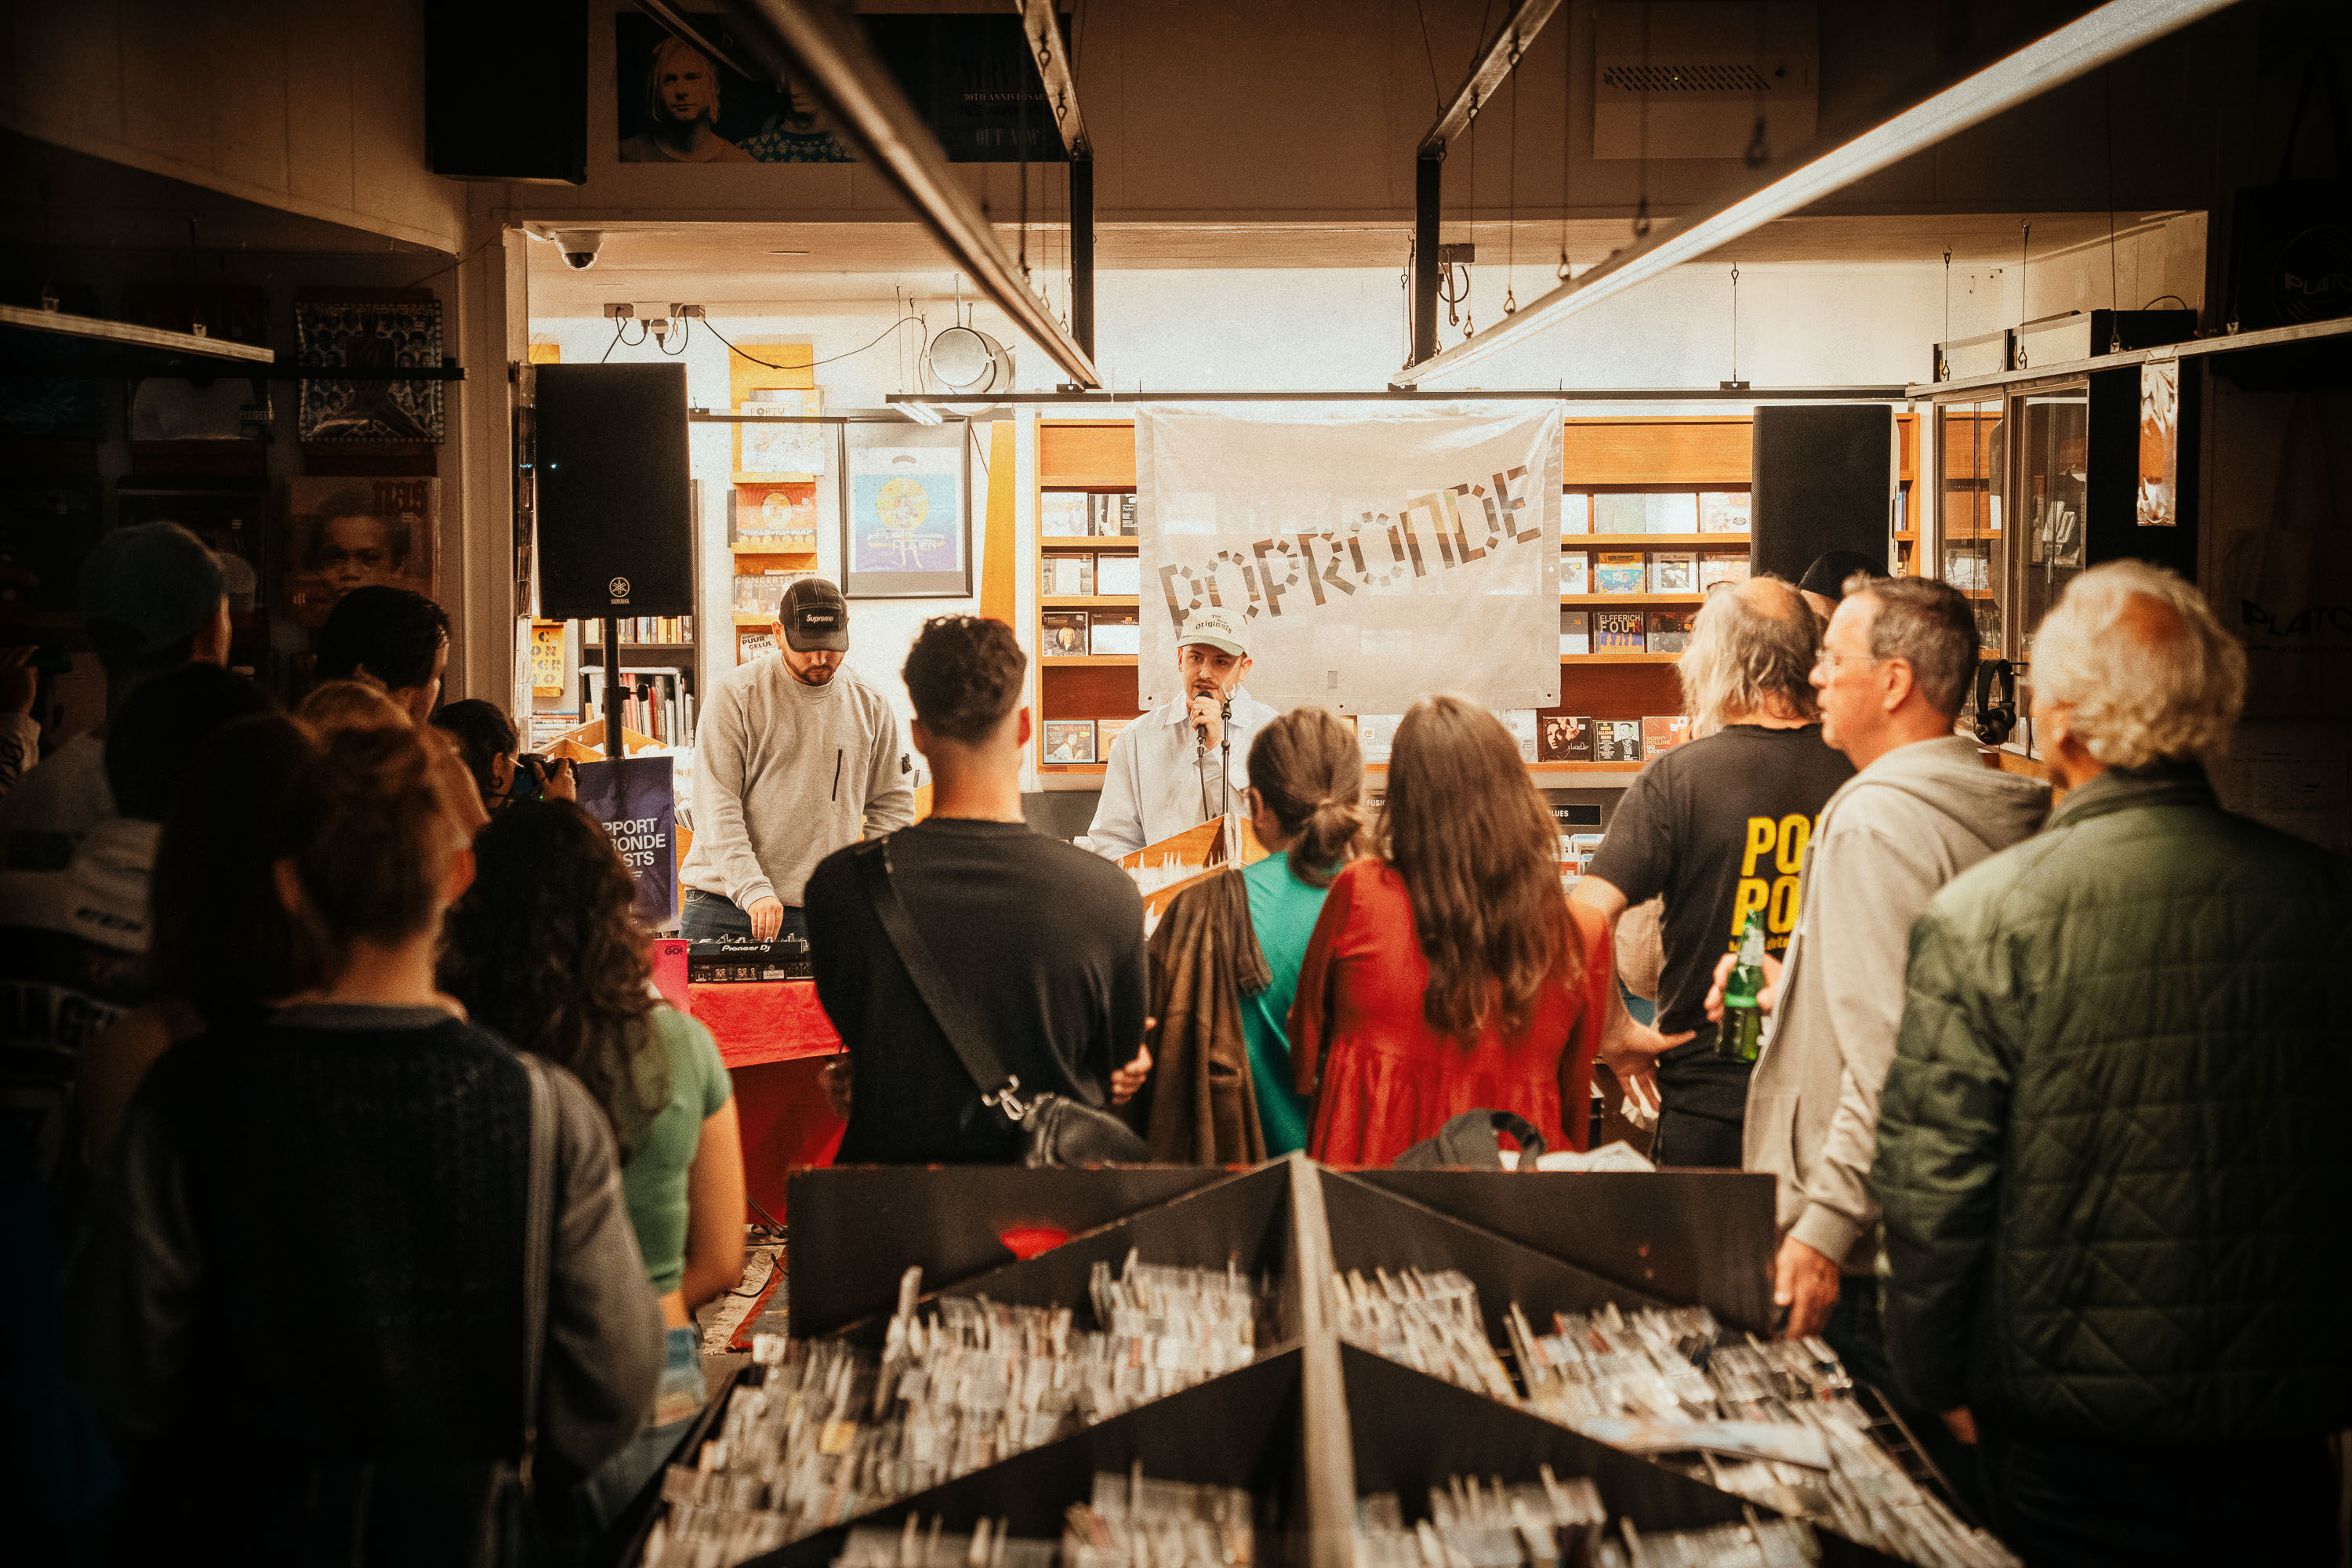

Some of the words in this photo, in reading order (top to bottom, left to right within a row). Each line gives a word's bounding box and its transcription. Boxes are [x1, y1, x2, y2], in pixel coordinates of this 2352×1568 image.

[975, 128, 1003, 146] OUT
[1158, 465, 1541, 641] POPRONDE
[806, 614, 834, 624] Supreme
[1599, 614, 1641, 623] ELFFERICH
[1600, 621, 1641, 633] FOUR
[742, 636, 765, 645] PUUR
[749, 641, 773, 650] GELUL
[1740, 813, 1821, 877] PO
[665, 947, 683, 956] GO!
